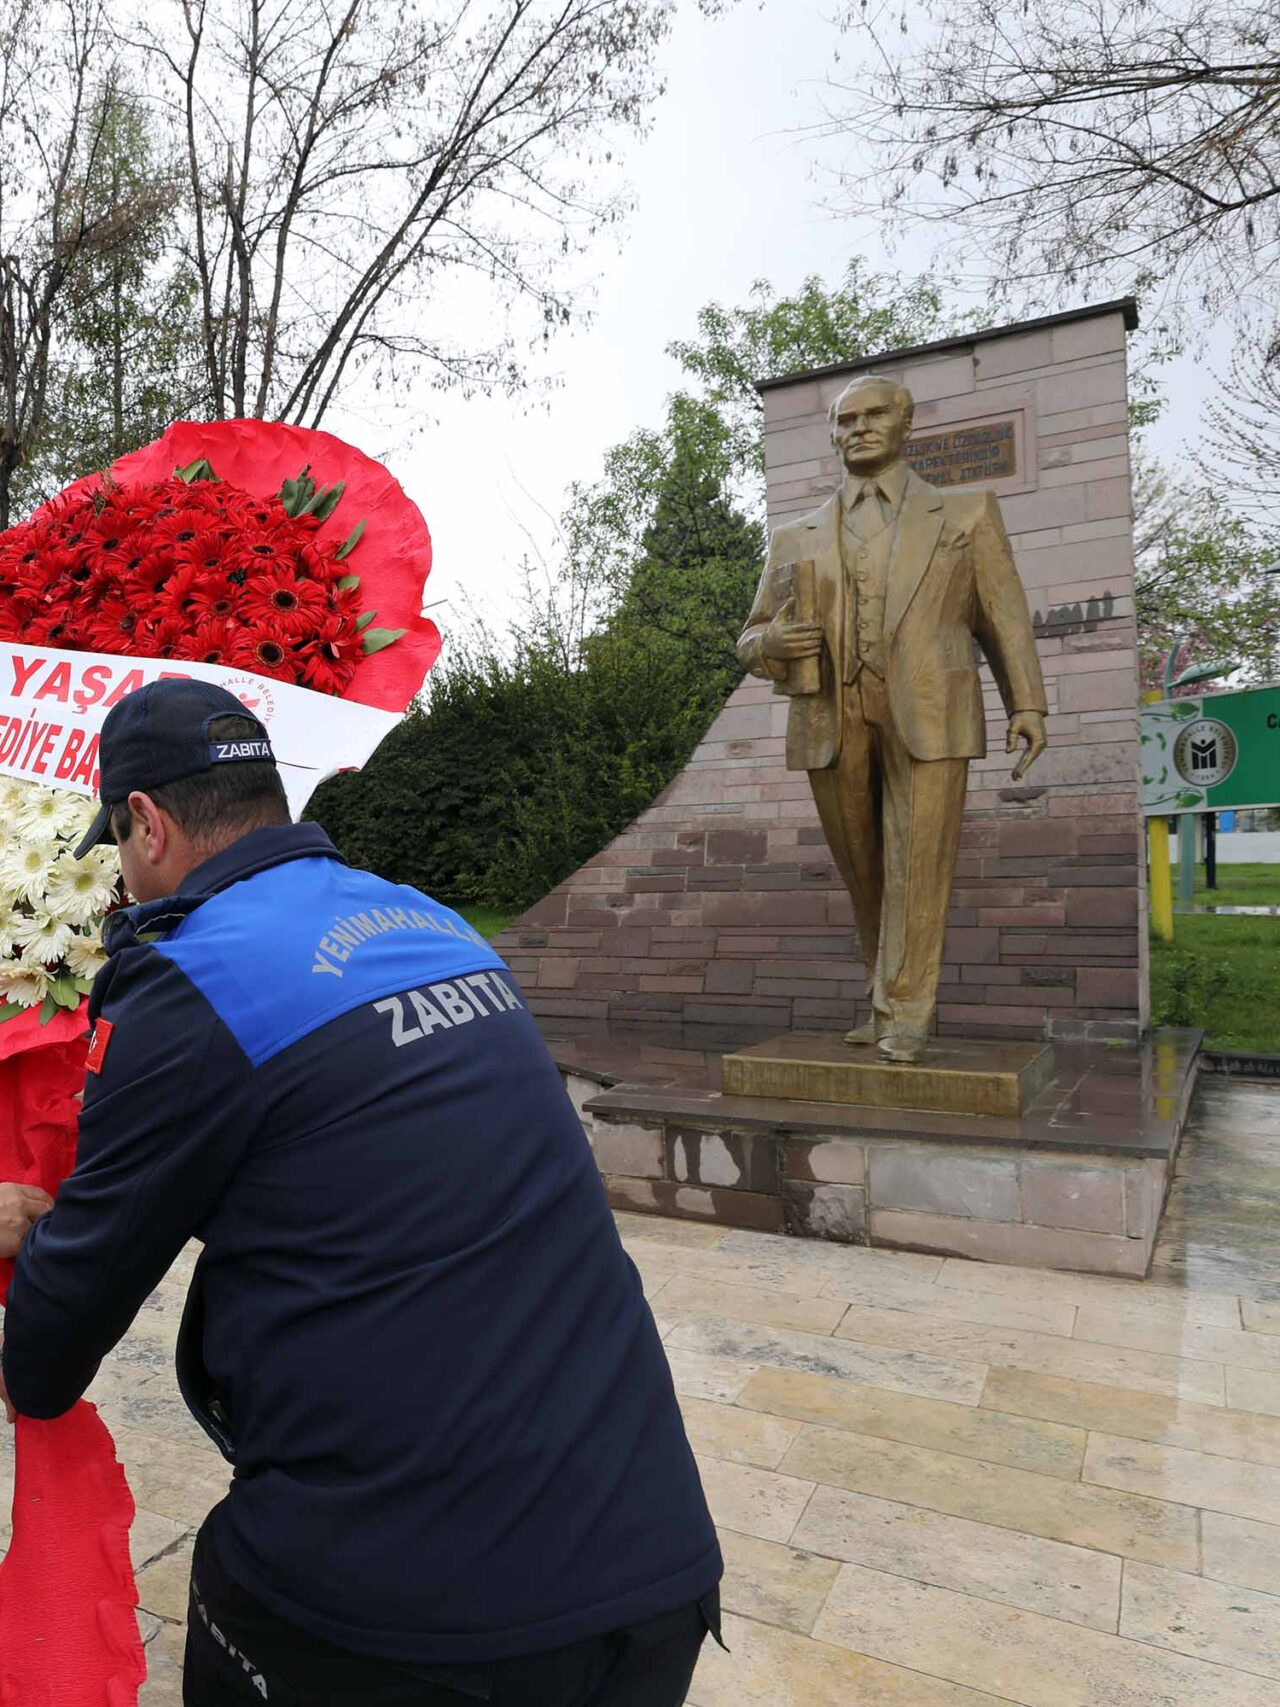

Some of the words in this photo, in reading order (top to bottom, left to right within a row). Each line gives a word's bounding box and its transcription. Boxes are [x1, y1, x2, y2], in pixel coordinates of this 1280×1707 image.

[10, 655, 191, 715] YAŞA
[216, 742, 271, 758] ZABITA
[373, 971, 524, 1048] ZABITA
